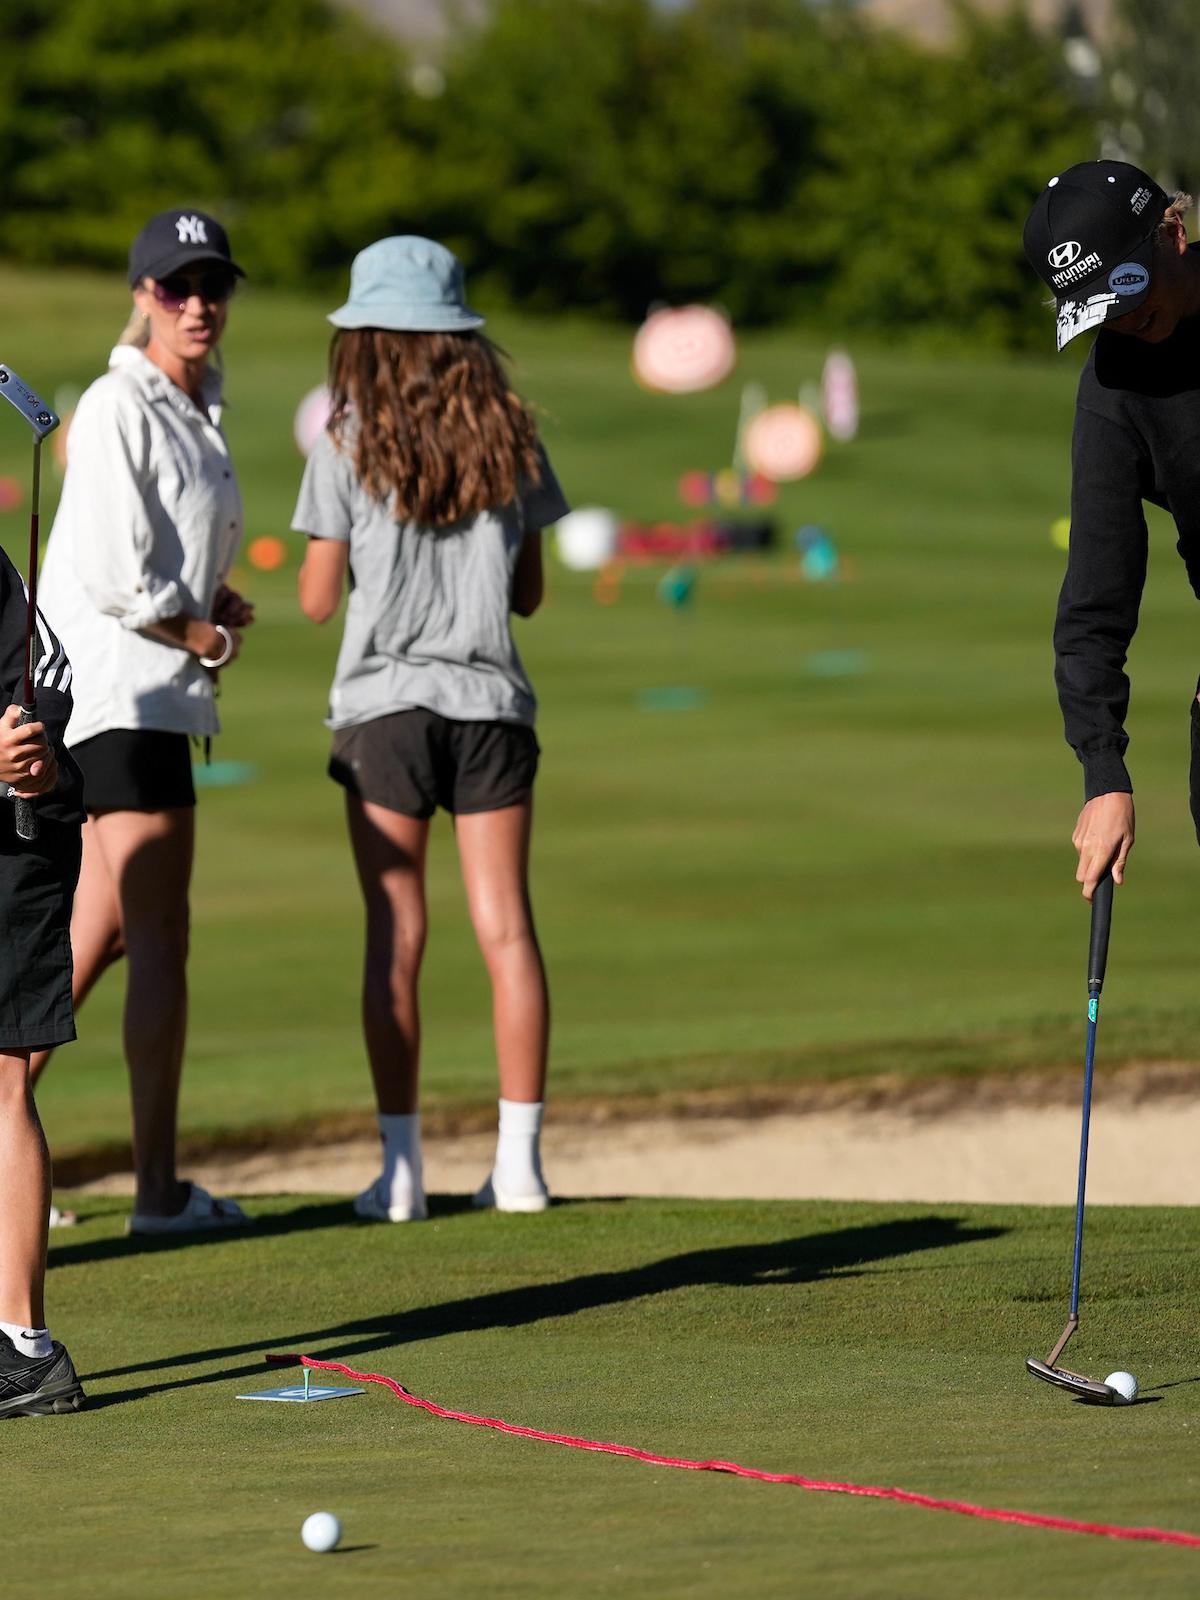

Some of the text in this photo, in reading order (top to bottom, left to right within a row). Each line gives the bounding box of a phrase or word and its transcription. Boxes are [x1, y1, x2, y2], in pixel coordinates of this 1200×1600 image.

[1132, 189, 1153, 215] TRADE
[175, 215, 208, 244] NY
[1052, 252, 1101, 286] HYUNDAI
[1070, 261, 1103, 283] ZEALAND
